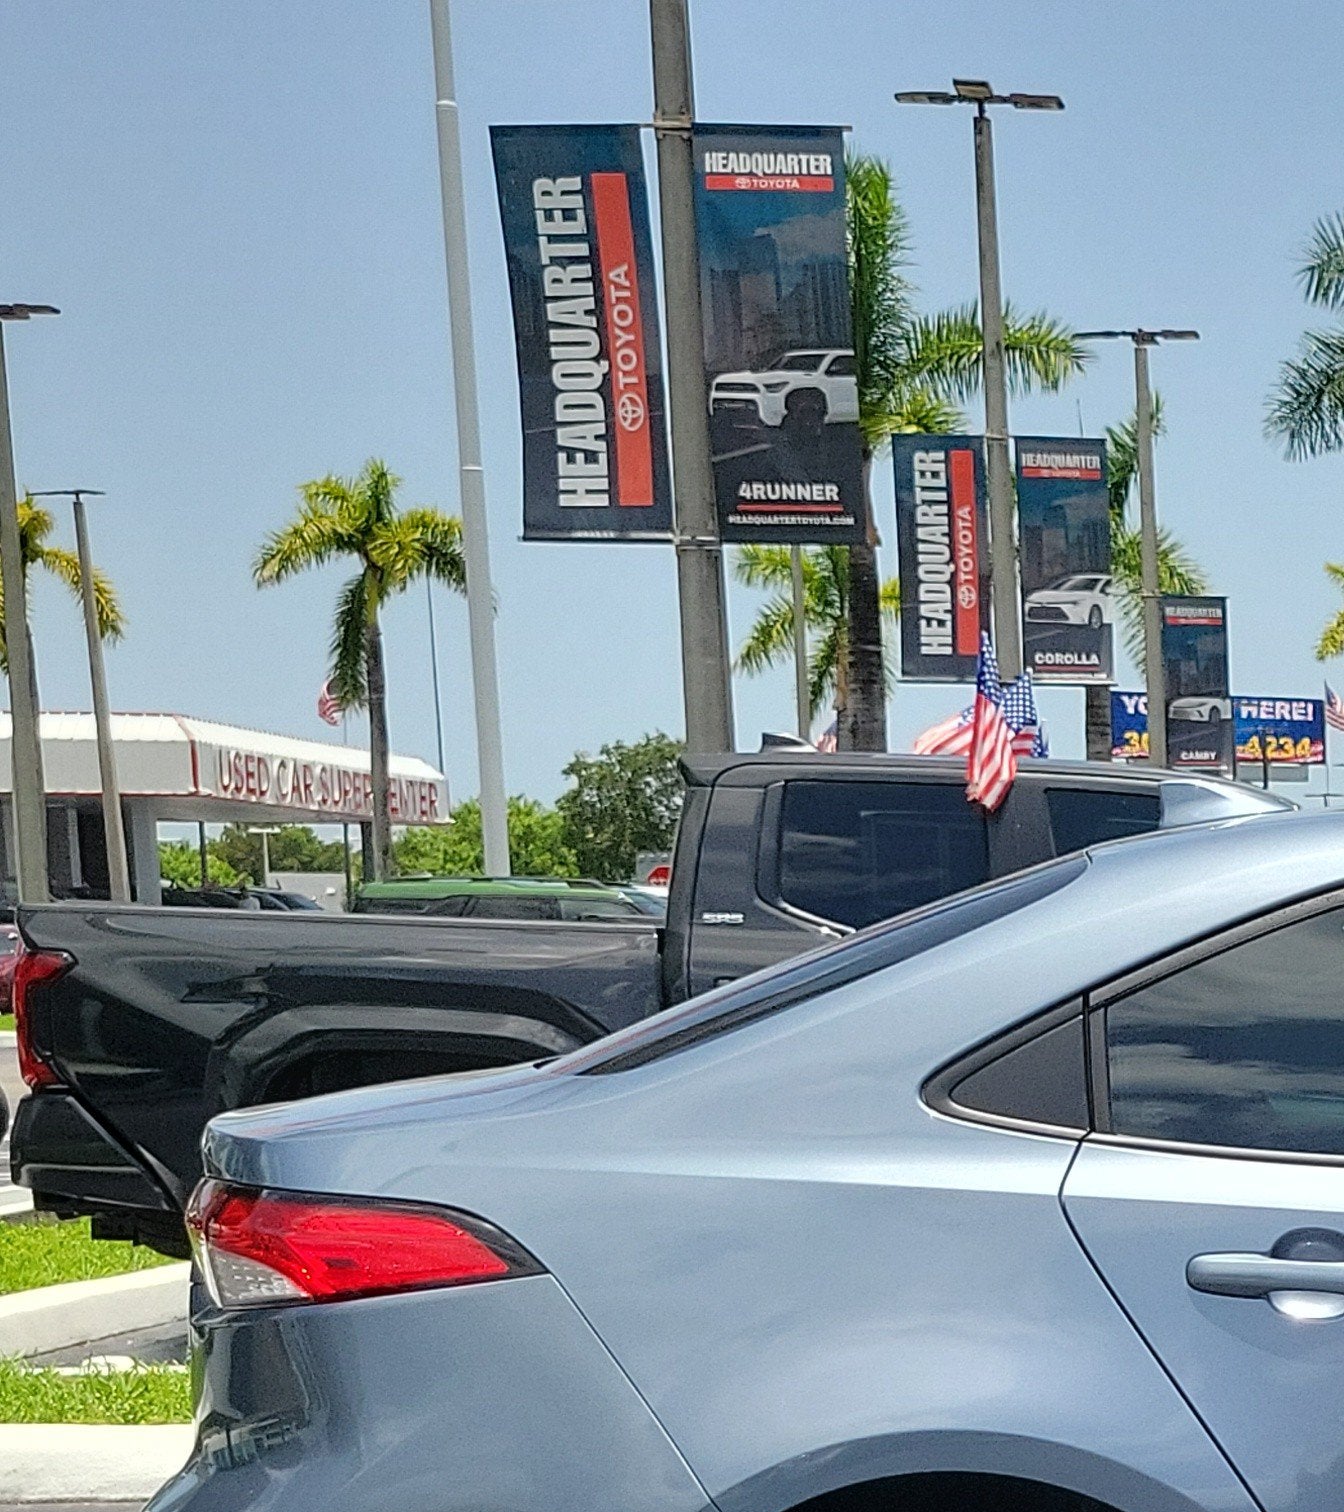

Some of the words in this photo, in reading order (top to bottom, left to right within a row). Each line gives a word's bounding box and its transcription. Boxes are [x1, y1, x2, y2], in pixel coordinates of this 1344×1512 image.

[705, 151, 832, 177] HEADQUARTER
[752, 178, 800, 189] TOYOTA
[608, 263, 640, 390] TOYOTA
[532, 175, 610, 508] HEADQUARTER
[1022, 453, 1101, 471] HEADQUARTER
[738, 481, 840, 501] 4RUNNER
[913, 450, 955, 656] HEADQUARTER
[957, 505, 975, 583] TOYOTA
[1034, 652, 1100, 665] COROLLA
[1240, 699, 1314, 721] HERE!
[219, 750, 270, 796] USED
[276, 759, 313, 804] CAR
[388, 778, 439, 817] ENTER
